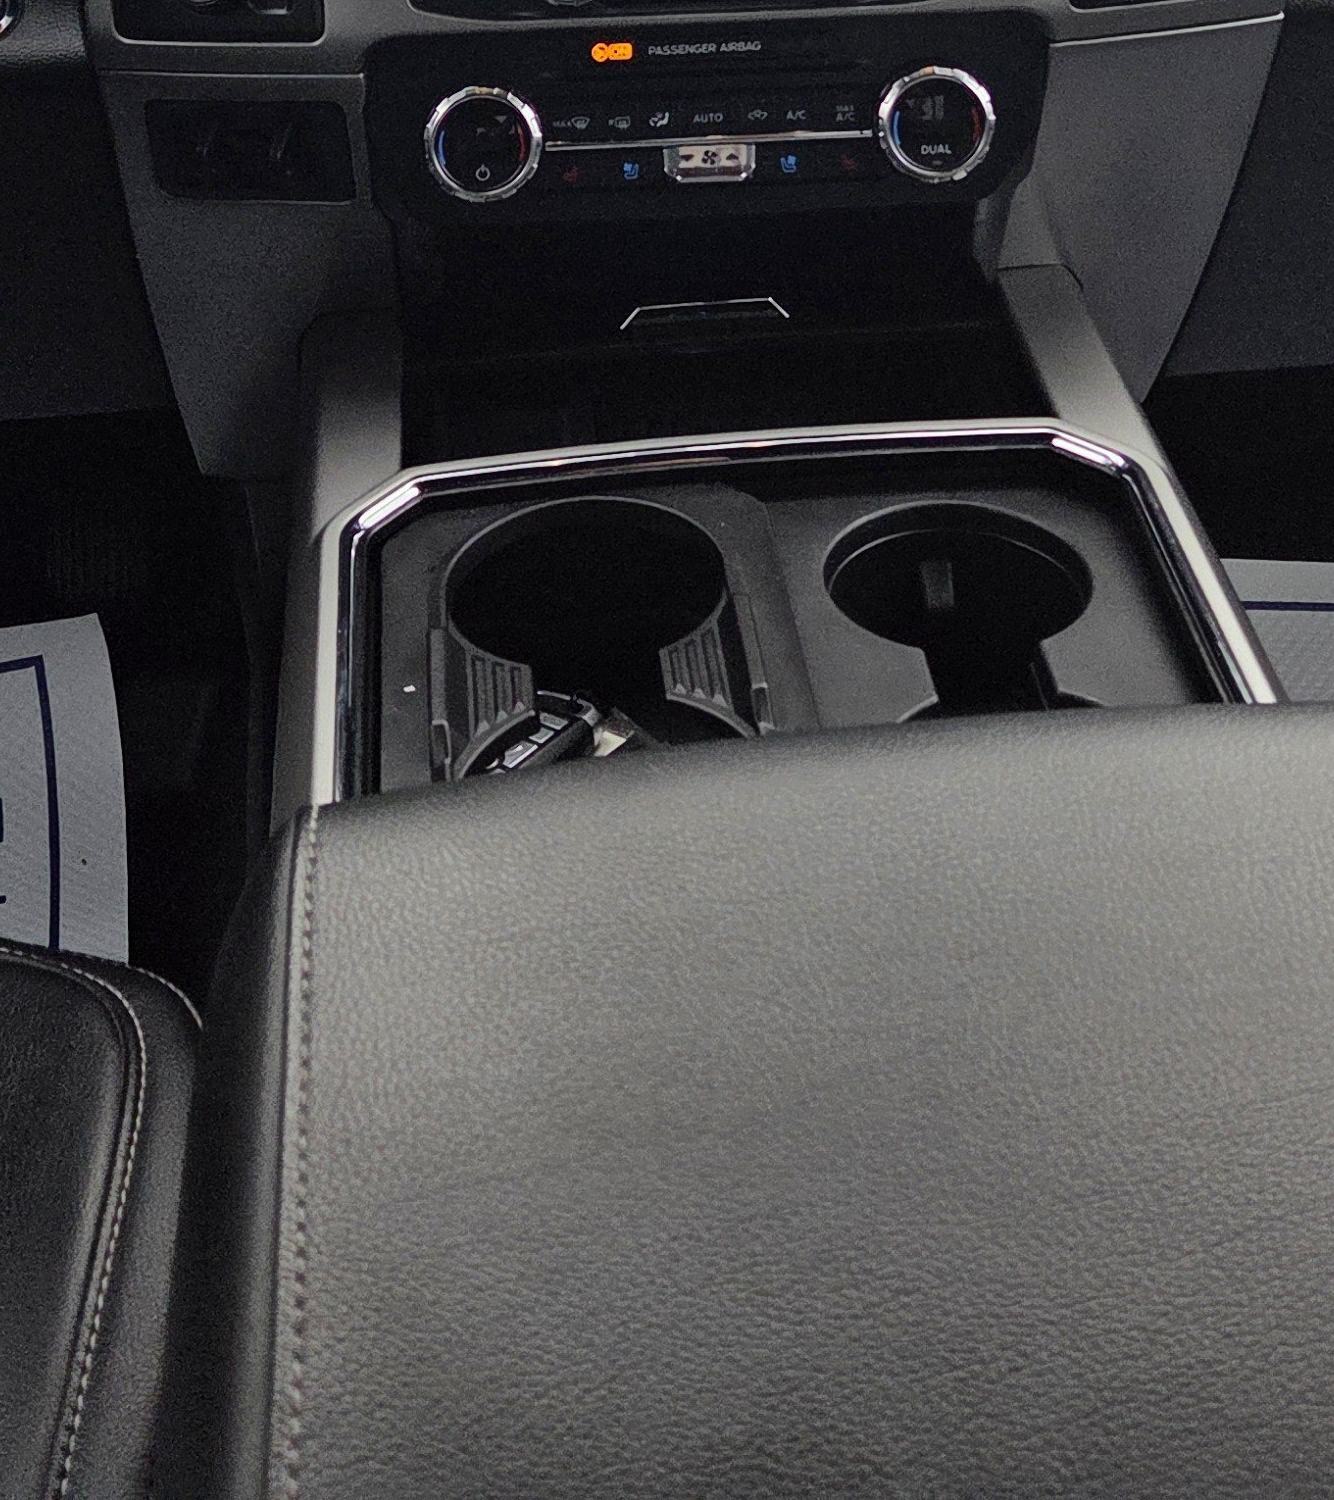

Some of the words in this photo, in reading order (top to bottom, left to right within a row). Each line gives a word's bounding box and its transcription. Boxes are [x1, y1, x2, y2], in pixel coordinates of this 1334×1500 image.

[648, 42, 717, 56] PASSENGER
[720, 40, 762, 53] AIRBAG
[693, 112, 724, 123] AUTO
[786, 109, 808, 121] A/C
[835, 111, 856, 123] A/C
[920, 144, 953, 155] DUAL
